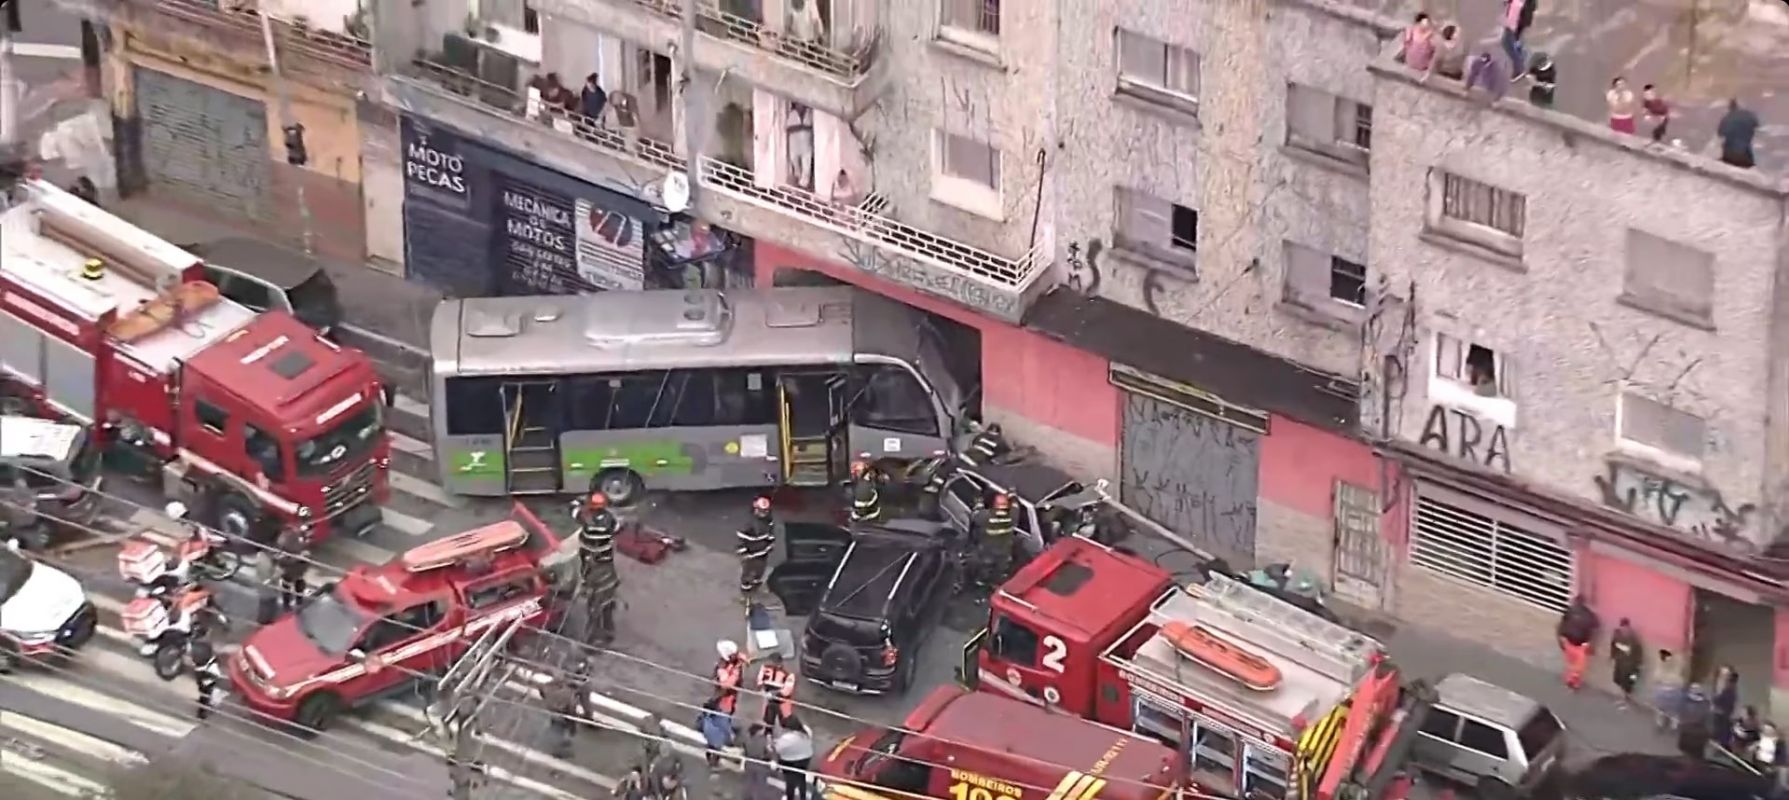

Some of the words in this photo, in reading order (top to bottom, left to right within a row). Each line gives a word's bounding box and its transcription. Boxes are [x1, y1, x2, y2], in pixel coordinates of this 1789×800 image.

[408, 142, 463, 173] MOTO
[507, 219, 565, 250] MOTOS
[1419, 404, 1512, 475] ARA
[1042, 635, 1067, 673] 2
[951, 767, 1022, 799] BOMBEIROS
